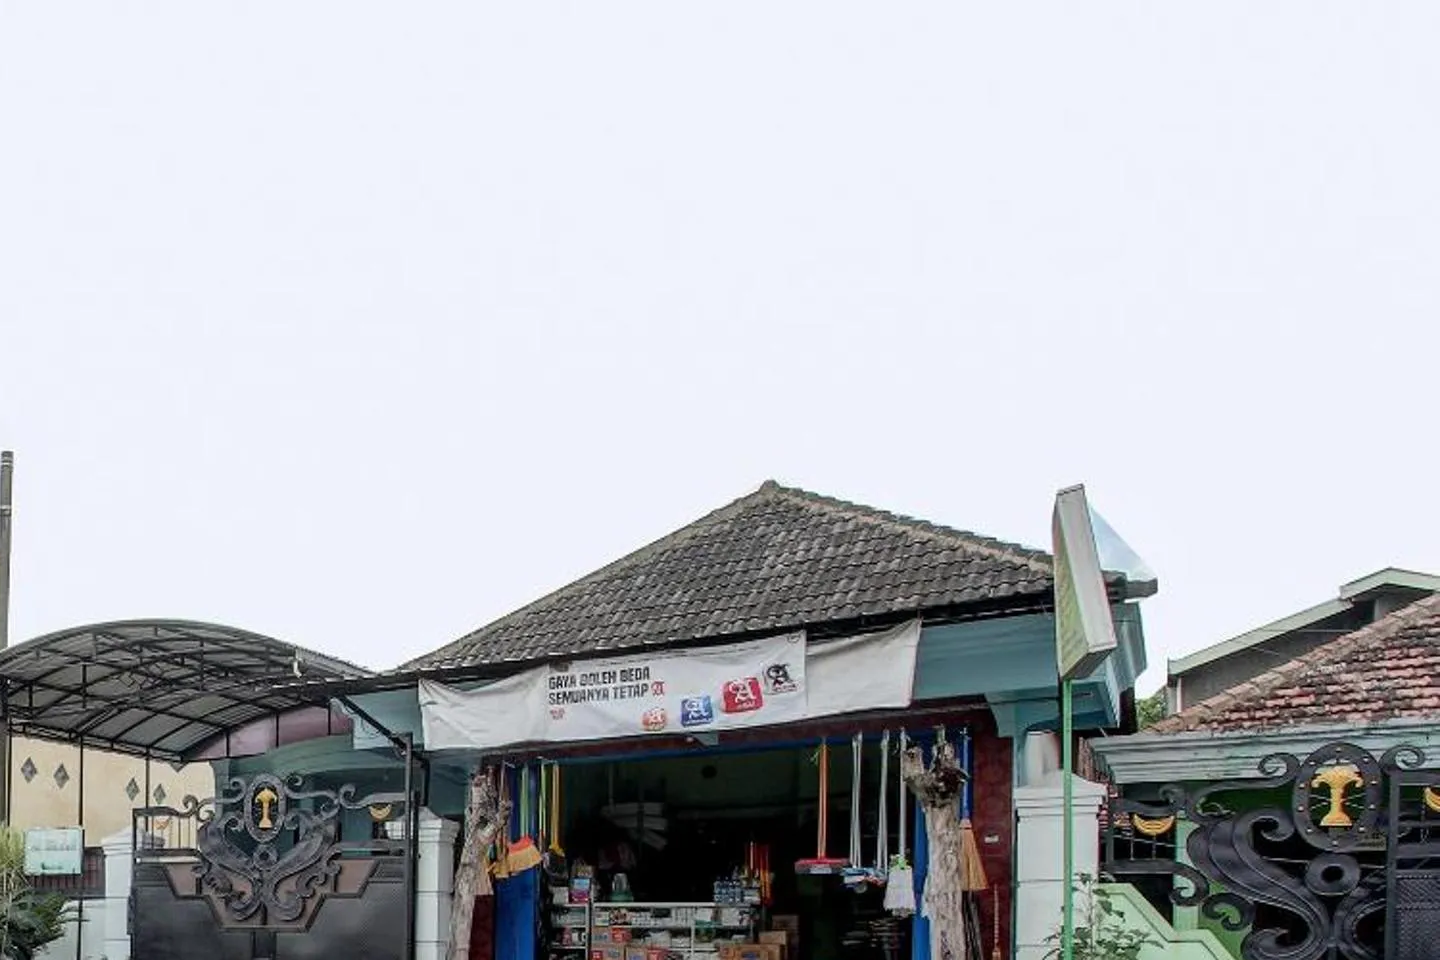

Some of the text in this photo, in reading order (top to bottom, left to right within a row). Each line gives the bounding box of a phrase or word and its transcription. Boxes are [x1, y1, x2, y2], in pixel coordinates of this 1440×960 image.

[549, 666, 650, 690] GAYA BOLEH BEDA
[549, 687, 609, 705] SEMUANYA
[612, 683, 649, 700] TETAP
